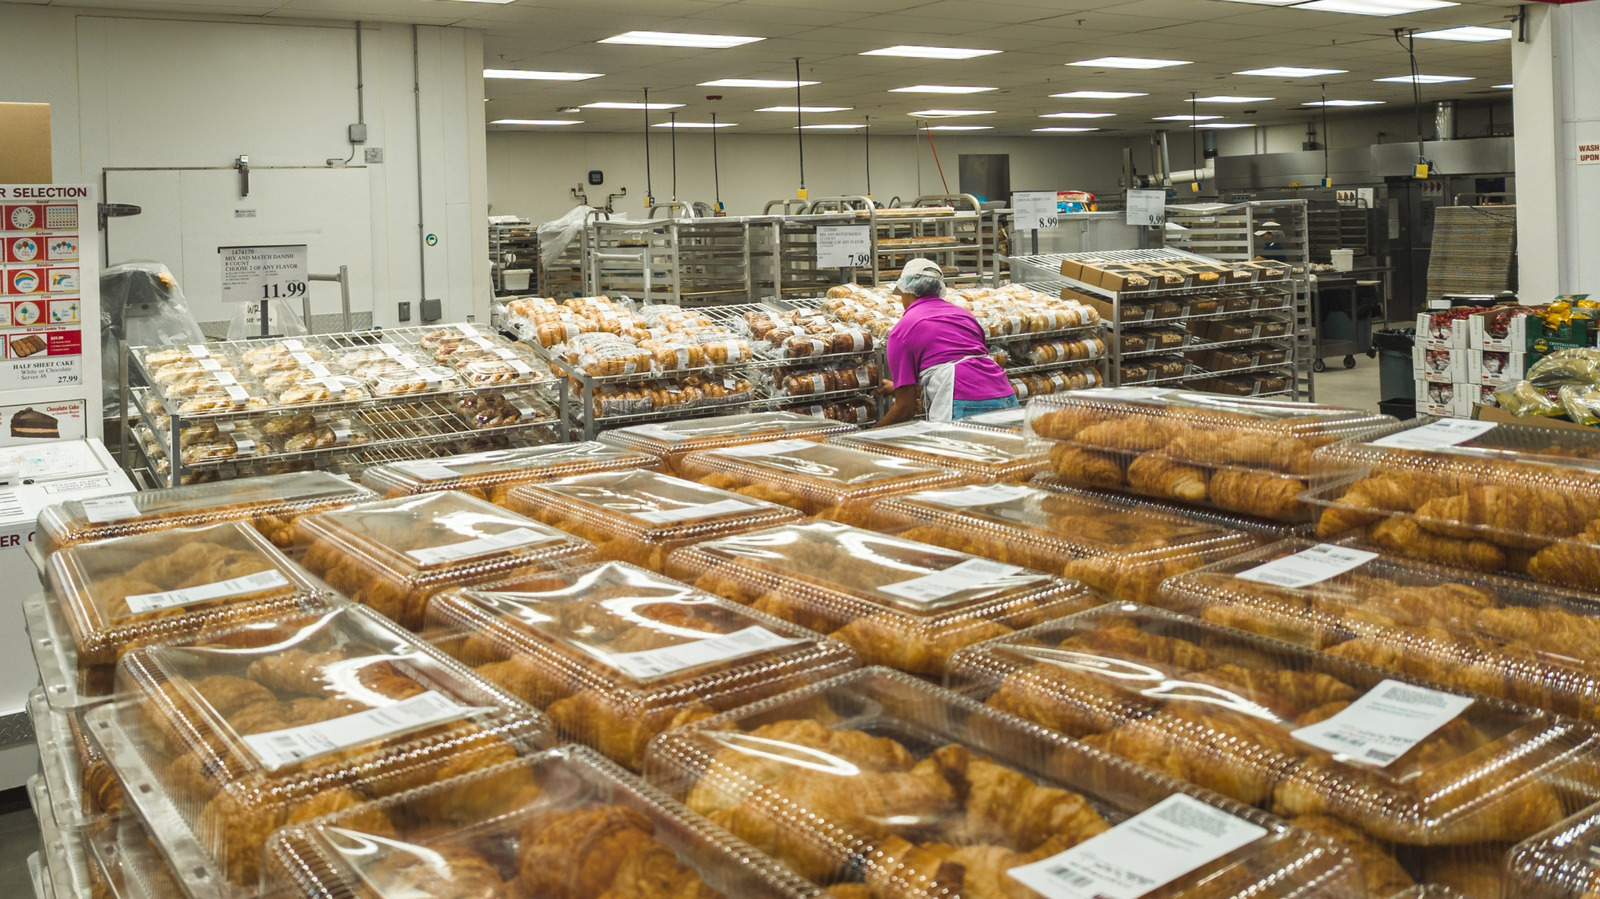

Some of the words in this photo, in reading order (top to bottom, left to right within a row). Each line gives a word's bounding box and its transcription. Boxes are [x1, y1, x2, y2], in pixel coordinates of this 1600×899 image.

[0, 188, 6, 197] R
[13, 187, 87, 197] SELECTION
[1039, 217, 1057, 228] 8.99
[1149, 215, 1165, 224] 9.99
[848, 254, 869, 266] 7.99
[262, 282, 306, 299] 11.99
[0, 534, 20, 547] ER
